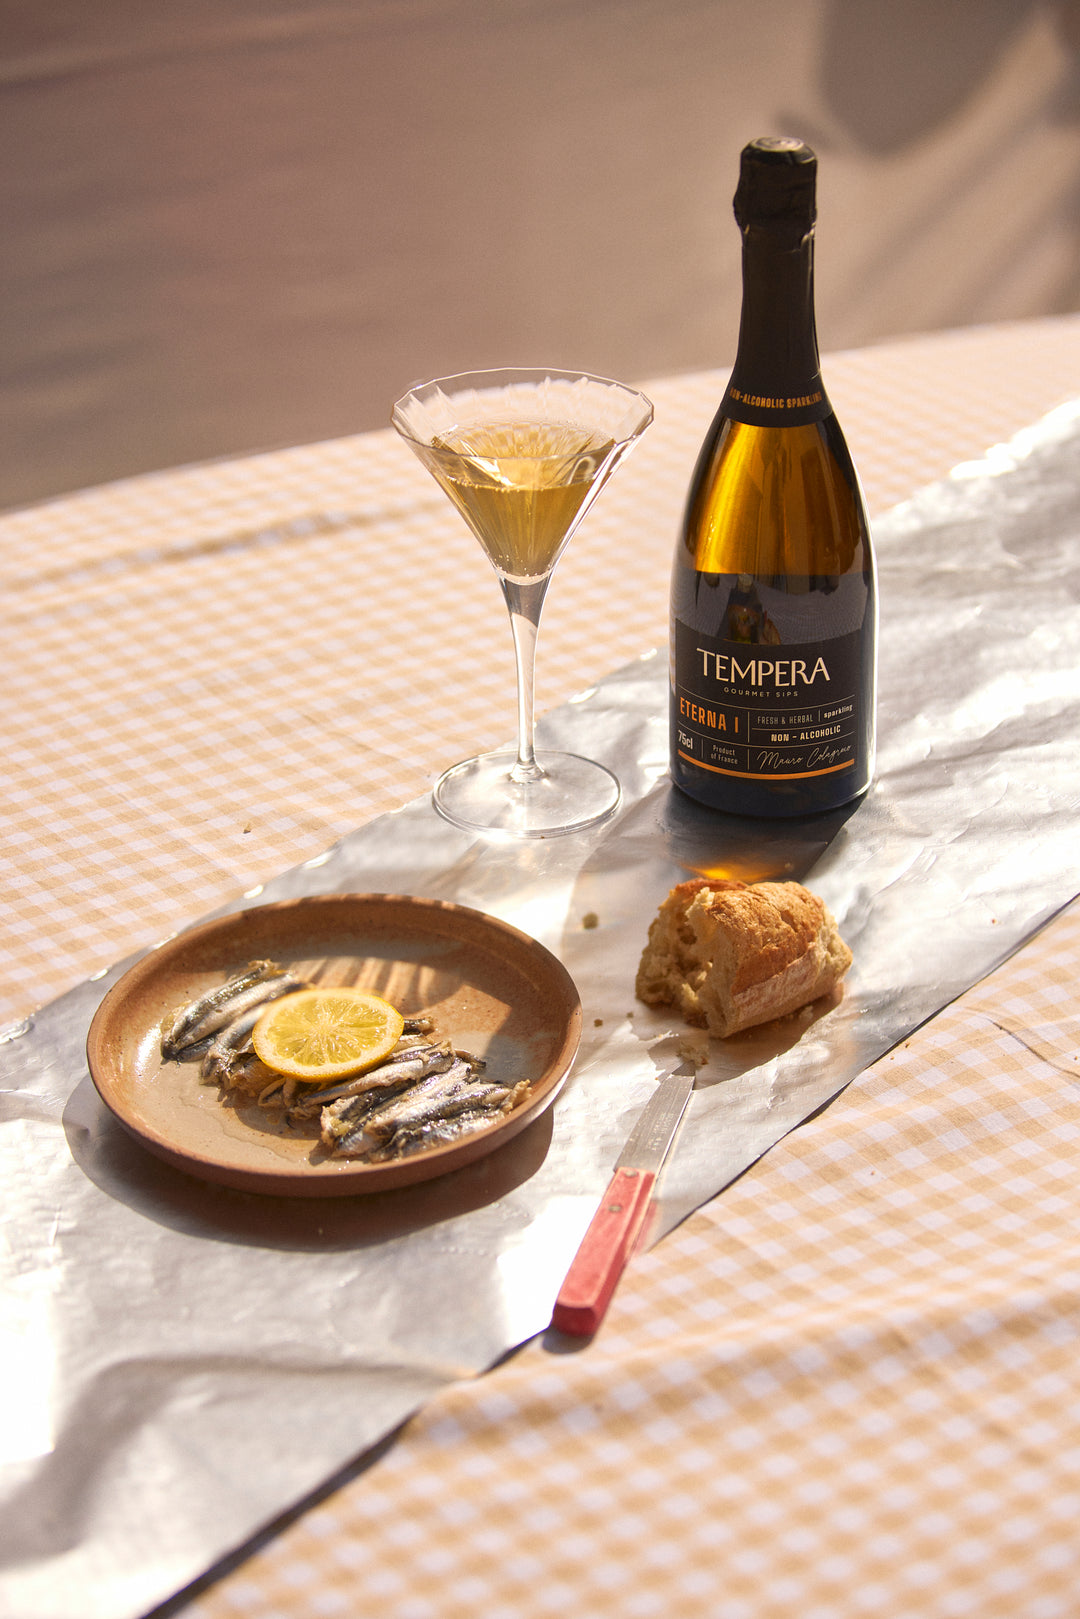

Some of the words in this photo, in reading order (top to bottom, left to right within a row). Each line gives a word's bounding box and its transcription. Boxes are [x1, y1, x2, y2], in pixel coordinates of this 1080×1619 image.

[696, 647, 831, 687] TEMPERA
[723, 686, 771, 697] GOURMET
[679, 696, 727, 731] ETERNA
[823, 704, 853, 719] sparkling
[757, 715, 779, 725] FRESH
[781, 716, 786, 725] &
[789, 714, 814, 724] HERBAL
[677, 729, 693, 750] 75cl
[771, 733, 790, 742] NON
[800, 724, 842, 741] ALCOHOLIC
[713, 744, 736, 756] Product
[718, 754, 739, 765] France
